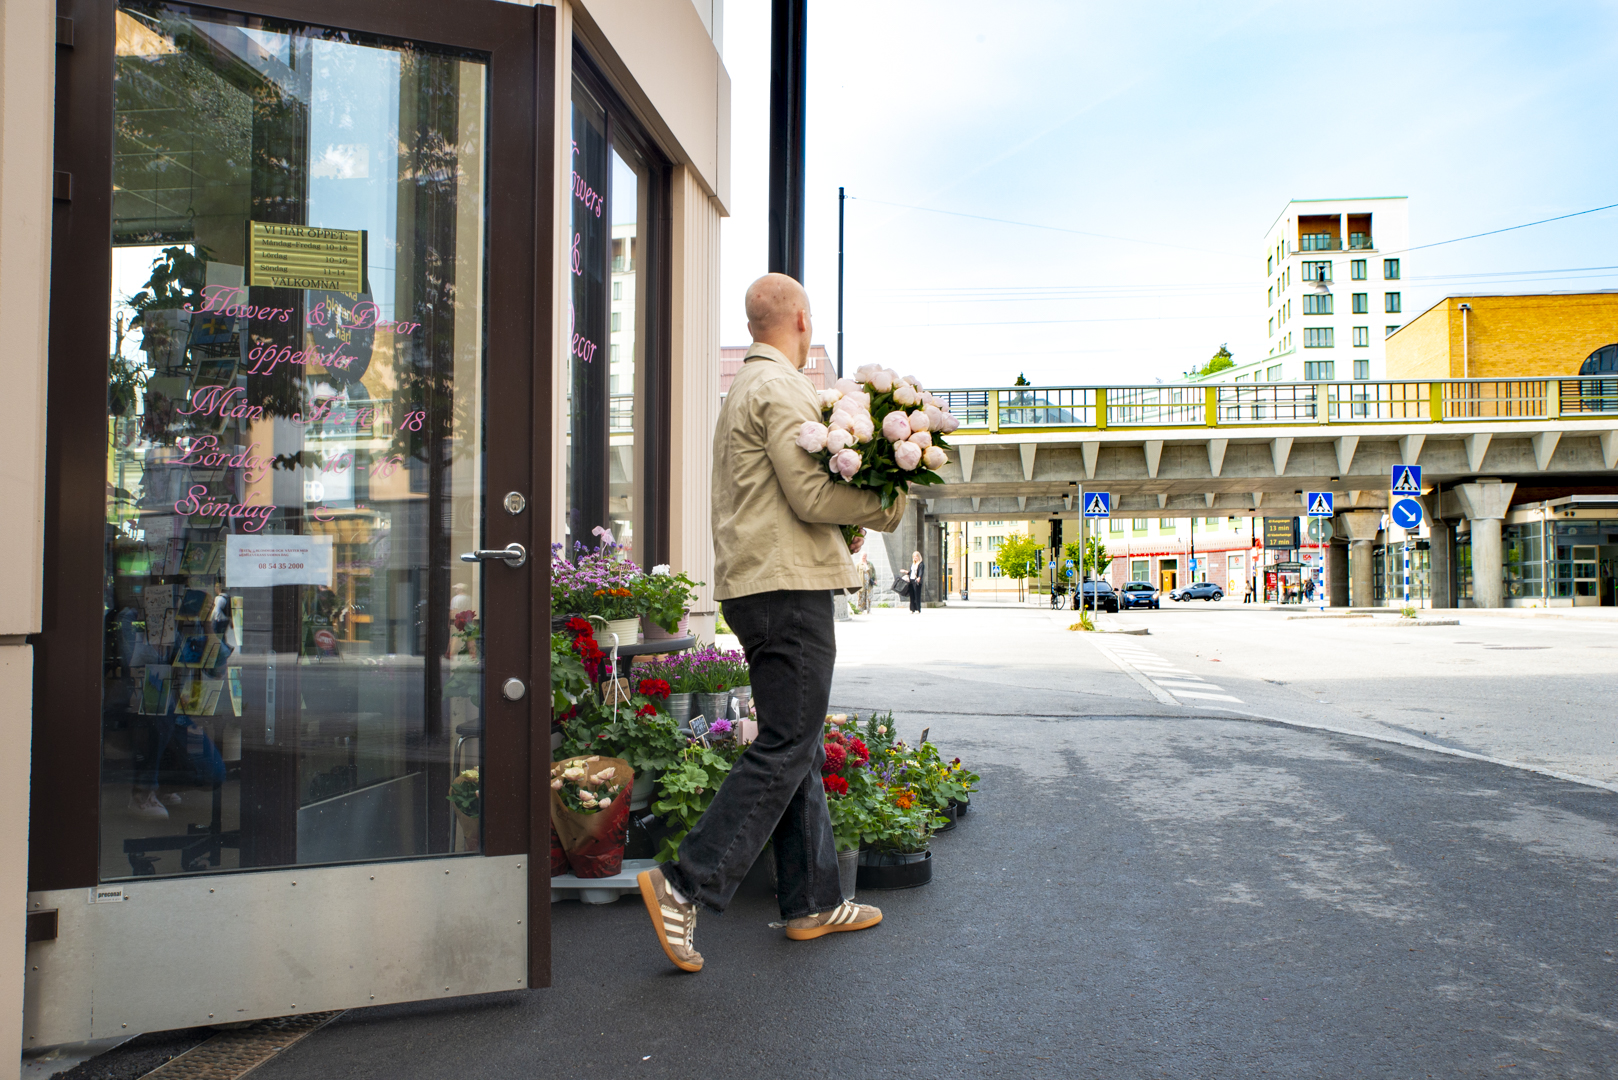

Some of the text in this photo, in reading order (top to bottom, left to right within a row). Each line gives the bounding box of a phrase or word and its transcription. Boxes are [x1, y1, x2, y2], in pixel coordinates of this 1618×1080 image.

[263, 225, 348, 240] VI HAR ÖPPET:
[261, 239, 348, 252] Måndag-Fredag 10-18
[260, 264, 346, 276] Söndag 11-14
[261, 251, 348, 265] Lördag 10-16
[271, 276, 340, 290] VÄLKOMNA!
[183, 284, 421, 335] Flowers & Decor
[247, 341, 358, 375] öppettider
[176, 385, 263, 419] Mån
[292, 395, 345, 425] Fre
[350, 407, 381, 428] 10
[399, 410, 426, 432] 18
[166, 434, 277, 484] Lördag
[322, 453, 354, 474] 10
[371, 456, 403, 477] 16
[174, 484, 277, 533] Söndag
